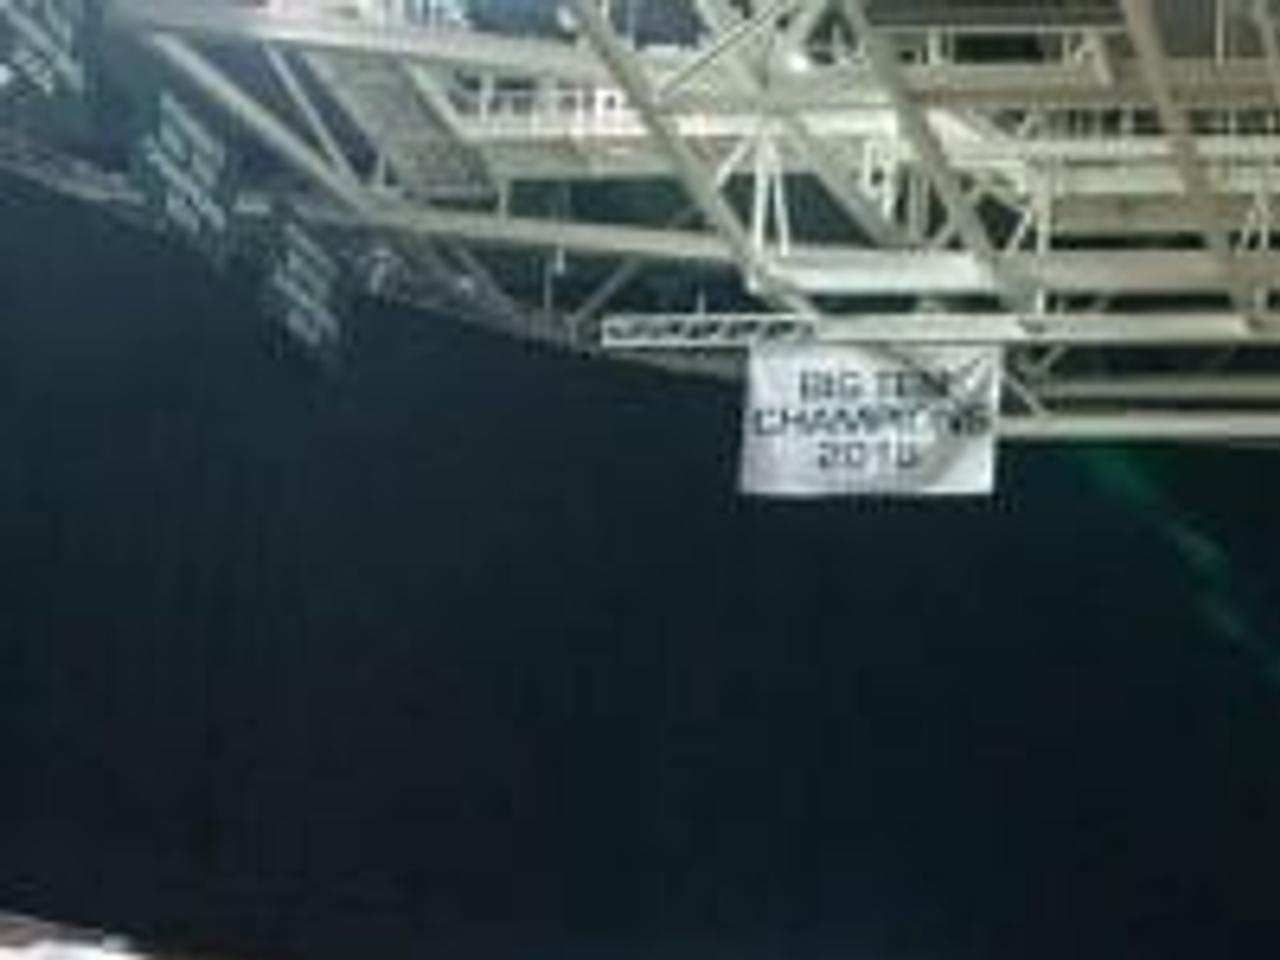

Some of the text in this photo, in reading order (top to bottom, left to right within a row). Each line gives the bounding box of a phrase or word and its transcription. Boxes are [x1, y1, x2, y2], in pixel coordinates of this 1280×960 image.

[799, 370, 949, 400] BIG TEN
[754, 403, 993, 438] CHAMPIONS
